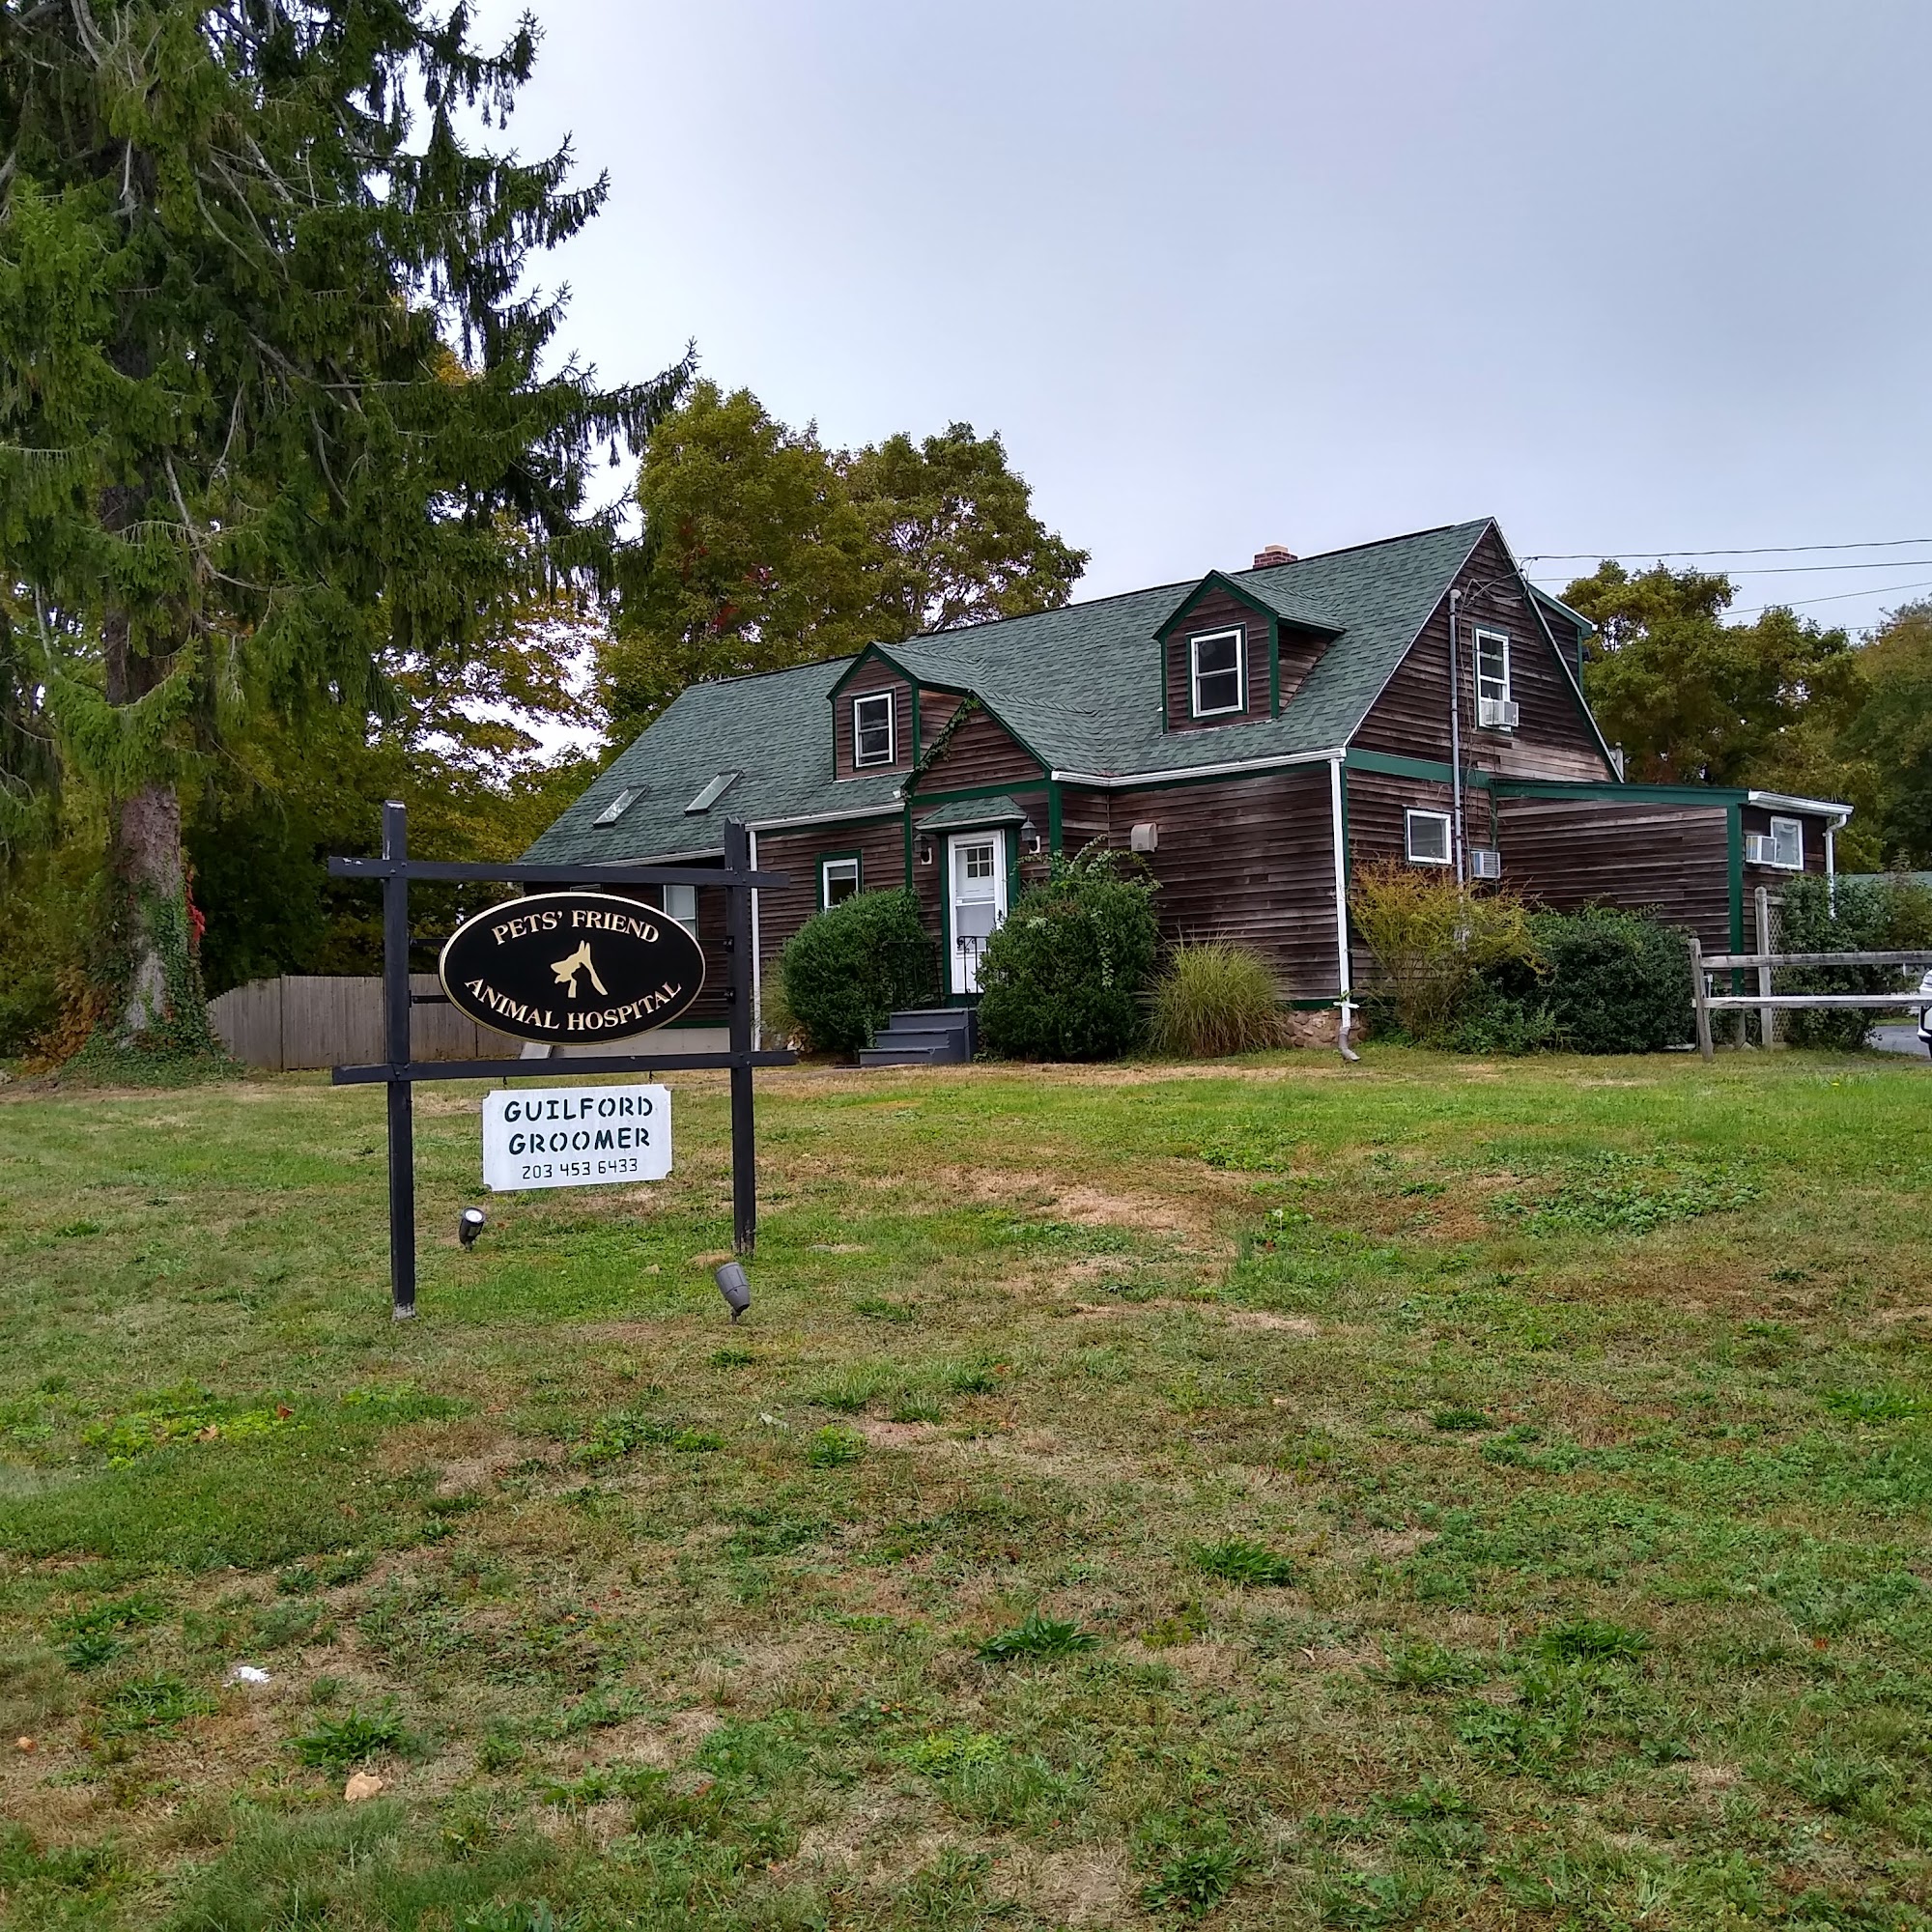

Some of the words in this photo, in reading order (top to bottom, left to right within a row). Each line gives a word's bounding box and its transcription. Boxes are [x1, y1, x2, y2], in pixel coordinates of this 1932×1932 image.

[571, 909, 660, 944] FRIEND
[464, 978, 560, 1030] ANIMAL
[566, 980, 682, 1031] HOSPITAL
[504, 1095, 653, 1122] GUILFORD
[508, 1126, 650, 1155] GROOMER
[522, 1164, 553, 1179] 203
[559, 1161, 590, 1177] 453
[598, 1158, 638, 1174] 6433
